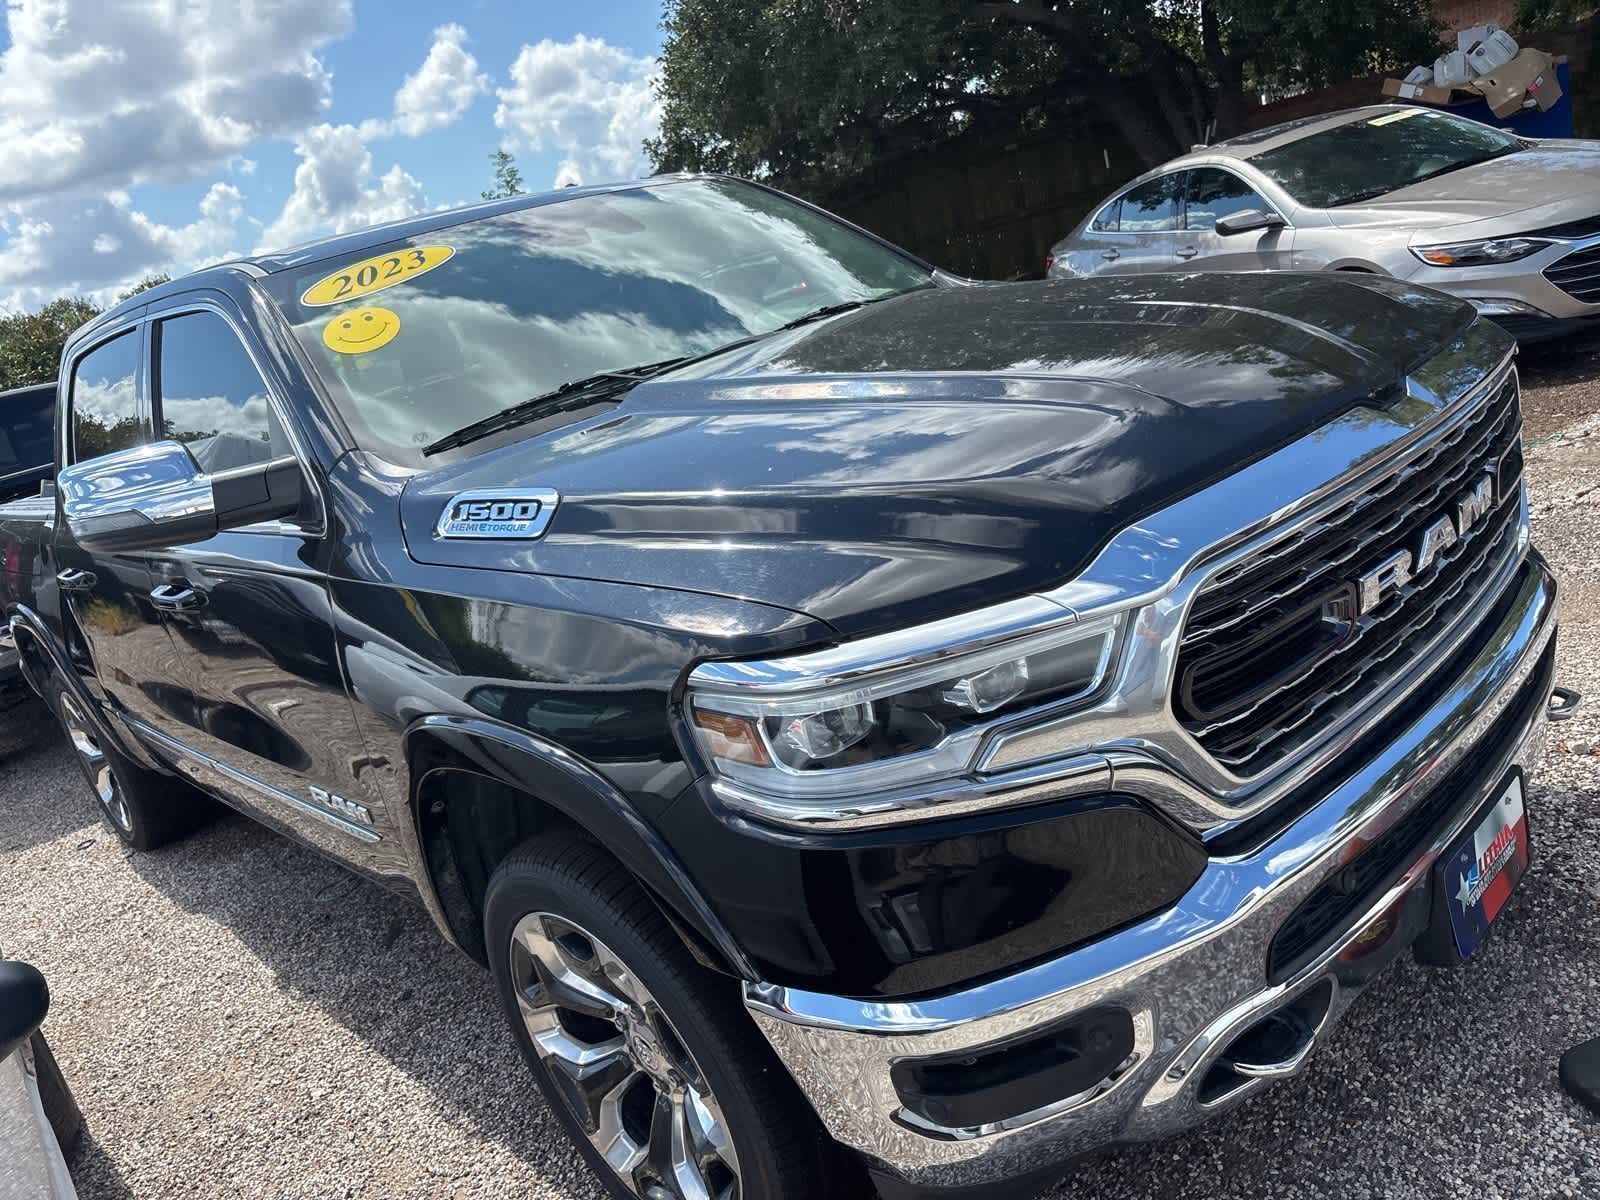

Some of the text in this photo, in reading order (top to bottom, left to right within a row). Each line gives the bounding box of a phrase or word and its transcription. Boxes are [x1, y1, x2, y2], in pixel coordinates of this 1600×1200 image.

[332, 249, 426, 299] 2023
[457, 502, 538, 520] 1500
[1359, 473, 1492, 614] RAM
[309, 785, 373, 825] RAM
